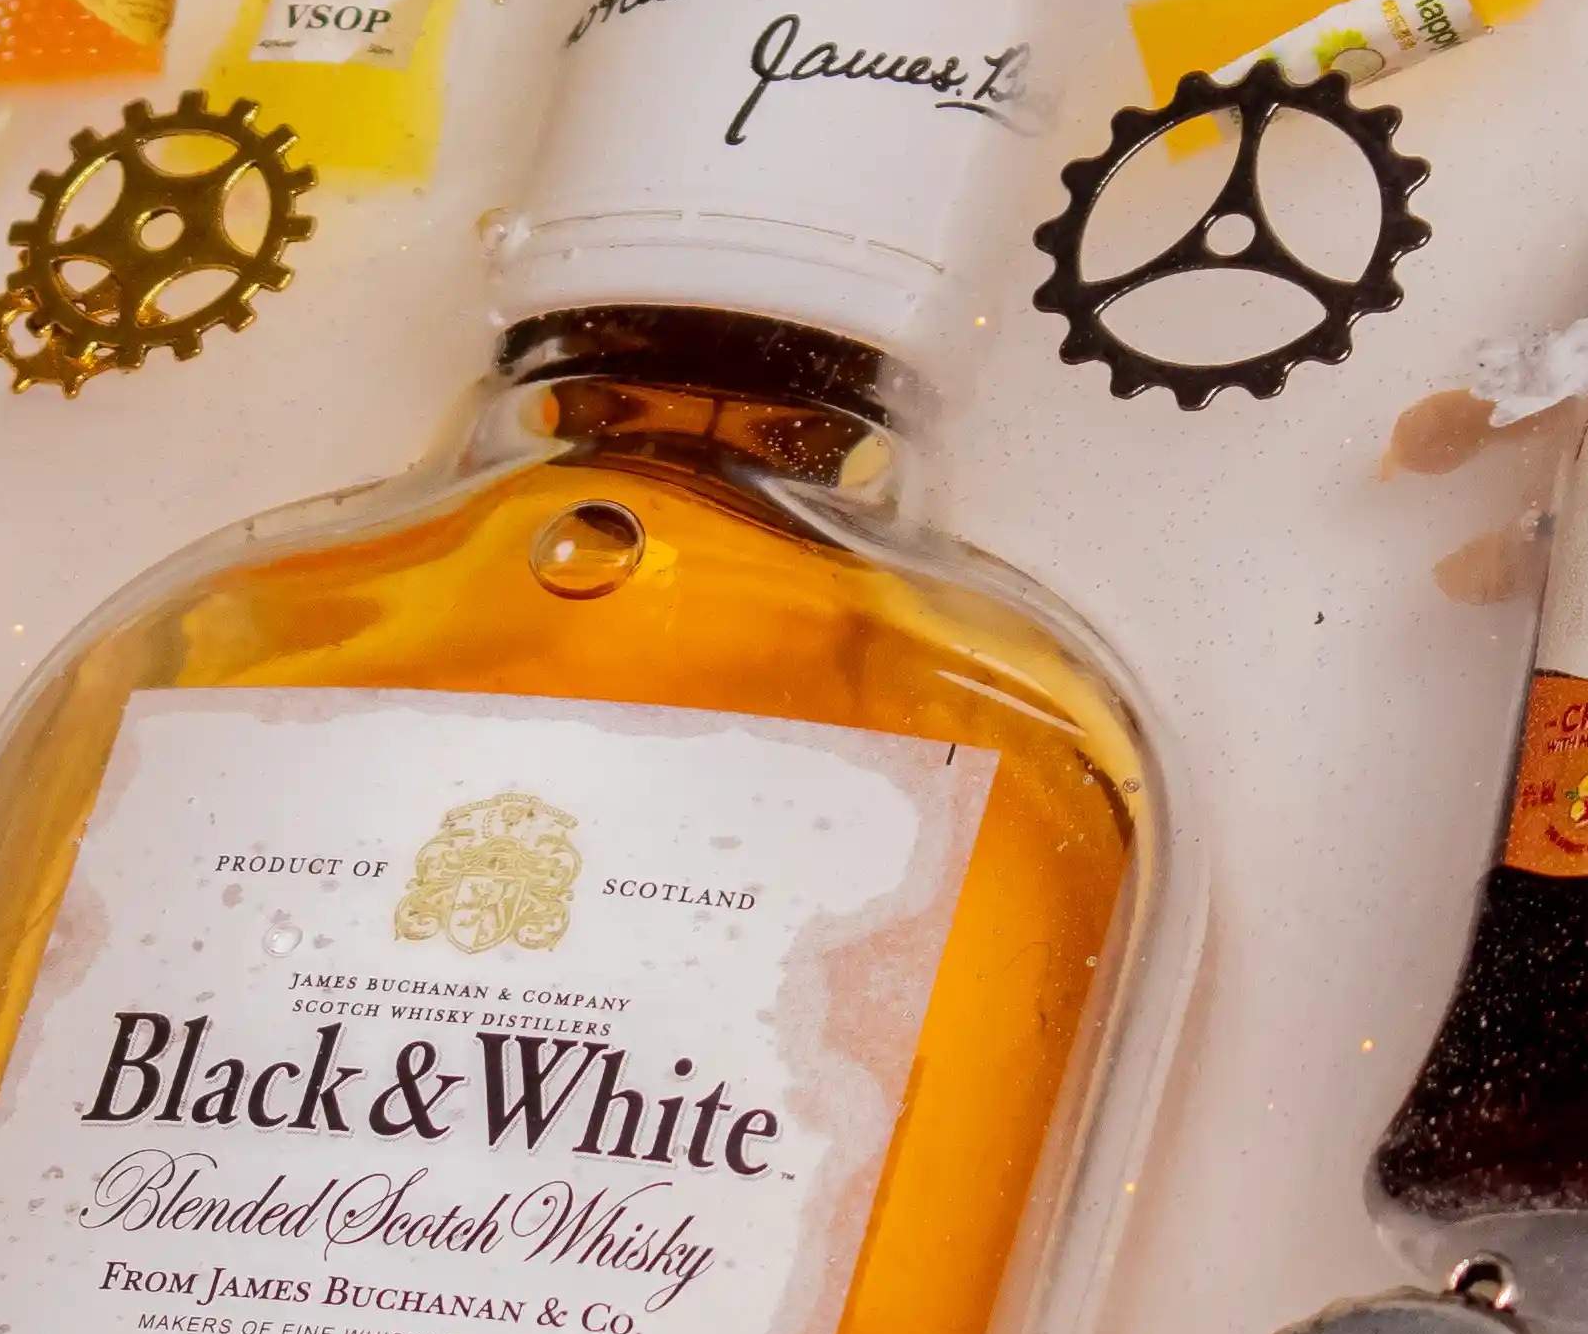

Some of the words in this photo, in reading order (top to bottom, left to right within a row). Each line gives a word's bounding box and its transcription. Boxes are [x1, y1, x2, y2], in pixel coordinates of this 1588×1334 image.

[287, 4, 392, 33] VSOP
[215, 855, 343, 877] PRODUCT
[353, 860, 389, 878] OF
[602, 878, 756, 911] SCOTLAND
[288, 972, 358, 990] JAMES
[366, 977, 490, 1000] BUCHANAN
[498, 987, 513, 1002] &
[523, 989, 632, 1012] COMPANY
[292, 999, 381, 1018] SCOTCH
[390, 1004, 475, 1025] WHISKY
[480, 1012, 613, 1037] DISTILLERS
[81, 1011, 365, 1133] Black
[368, 1040, 466, 1141] &
[475, 1030, 781, 1180] White
[78, 1148, 339, 1239] Blended
[323, 1167, 513, 1262] Scotch
[511, 1179, 714, 1313] Whisky
[536, 1297, 569, 1329] &
